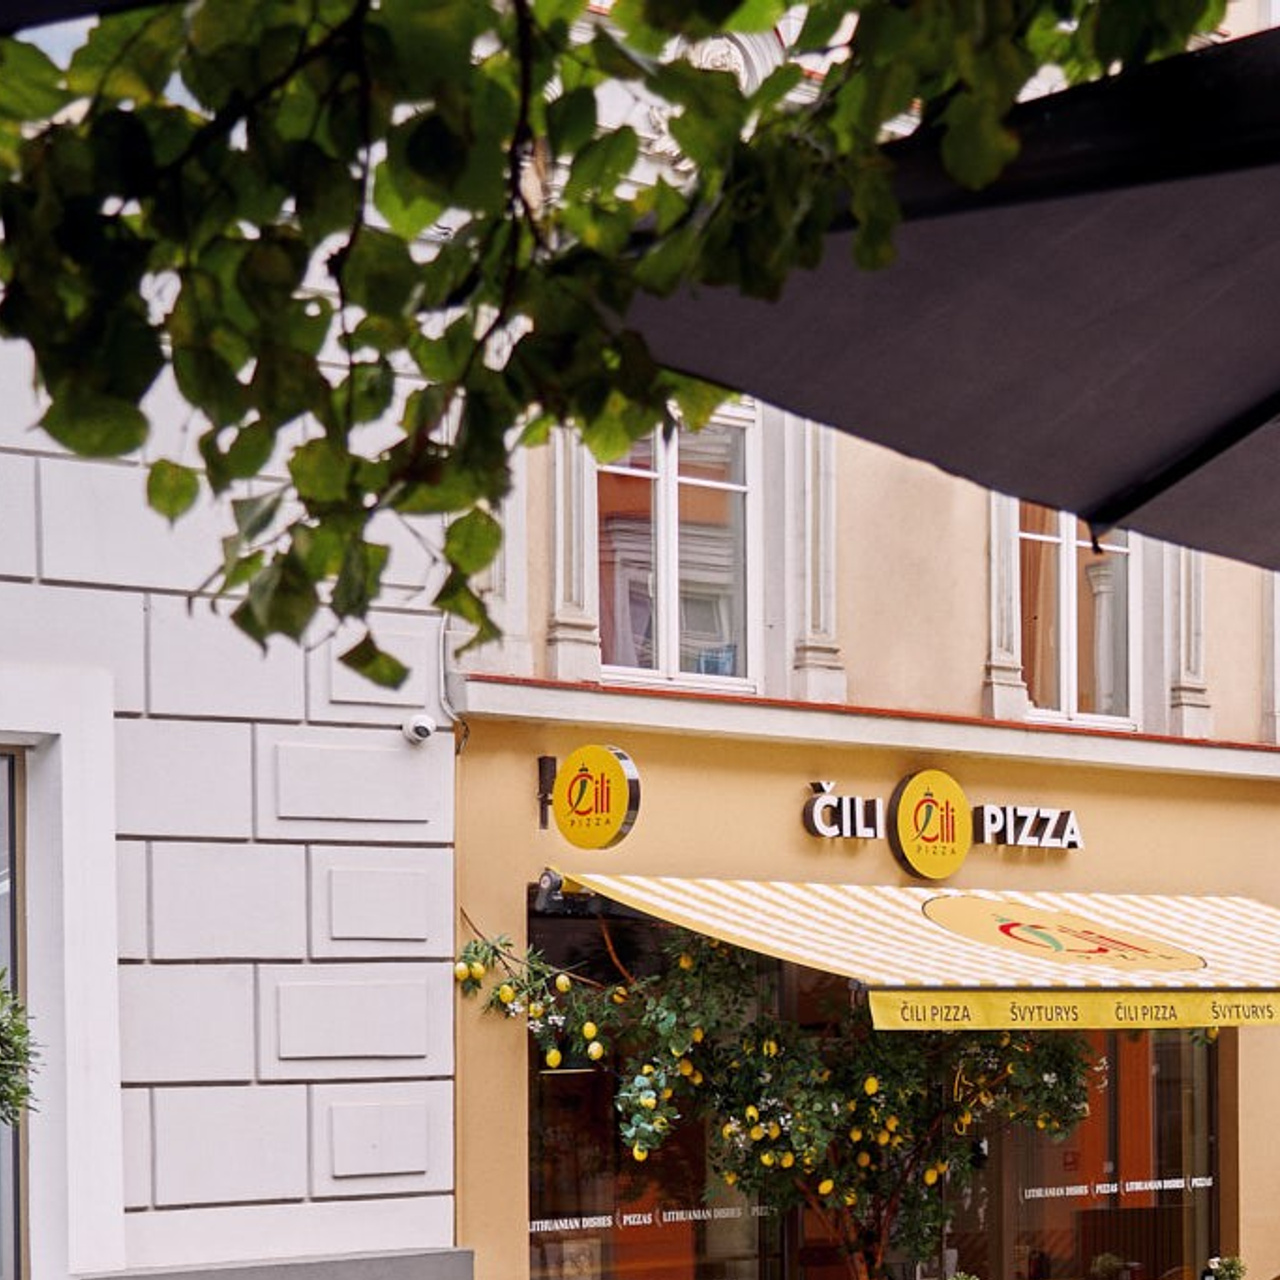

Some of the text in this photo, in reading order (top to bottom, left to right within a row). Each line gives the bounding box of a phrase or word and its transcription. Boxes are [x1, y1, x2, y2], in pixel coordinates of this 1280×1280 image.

[807, 781, 1083, 849] ČILI PIZZA
[901, 1001, 927, 1022] ČILI
[930, 1004, 972, 1022] PIZZA
[1009, 1001, 1079, 1022] ŠVYTURYS
[1115, 1001, 1139, 1021] ČILI
[1142, 1005, 1178, 1021] PIZZA
[1211, 1001, 1274, 1020] ŠVYTURYS
[582, 1215, 613, 1229] DISHES
[623, 1213, 652, 1226] PIZZAS
[662, 1209, 712, 1223] LITHUANIAN
